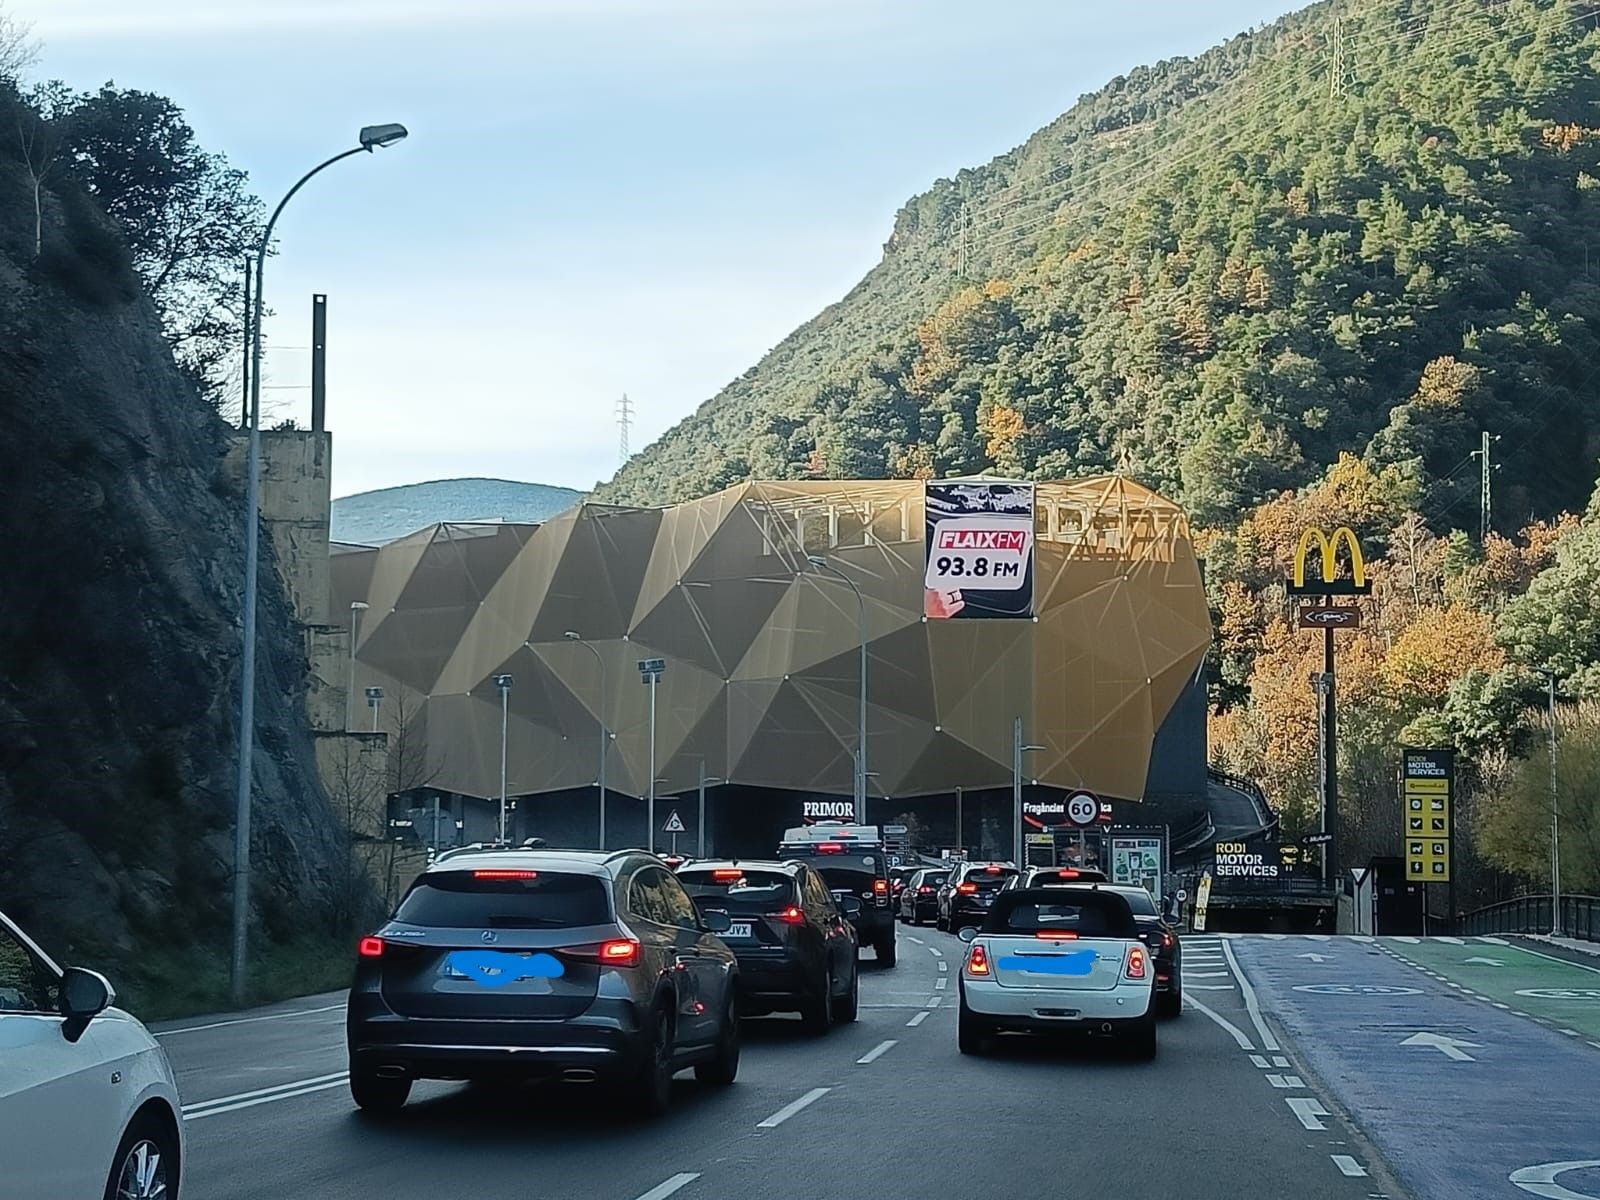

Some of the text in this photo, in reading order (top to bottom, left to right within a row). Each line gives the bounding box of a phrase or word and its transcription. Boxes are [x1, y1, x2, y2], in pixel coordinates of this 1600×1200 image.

[937, 556, 1019, 577] 93.8 FM
[803, 802, 854, 817] PRIMOR
[1072, 803, 1093, 816] 60
[1216, 843, 1246, 854] RODI
[1216, 854, 1263, 865] MOTOR
[1216, 865, 1278, 877] SERVICES
[730, 926, 748, 935] JVX
